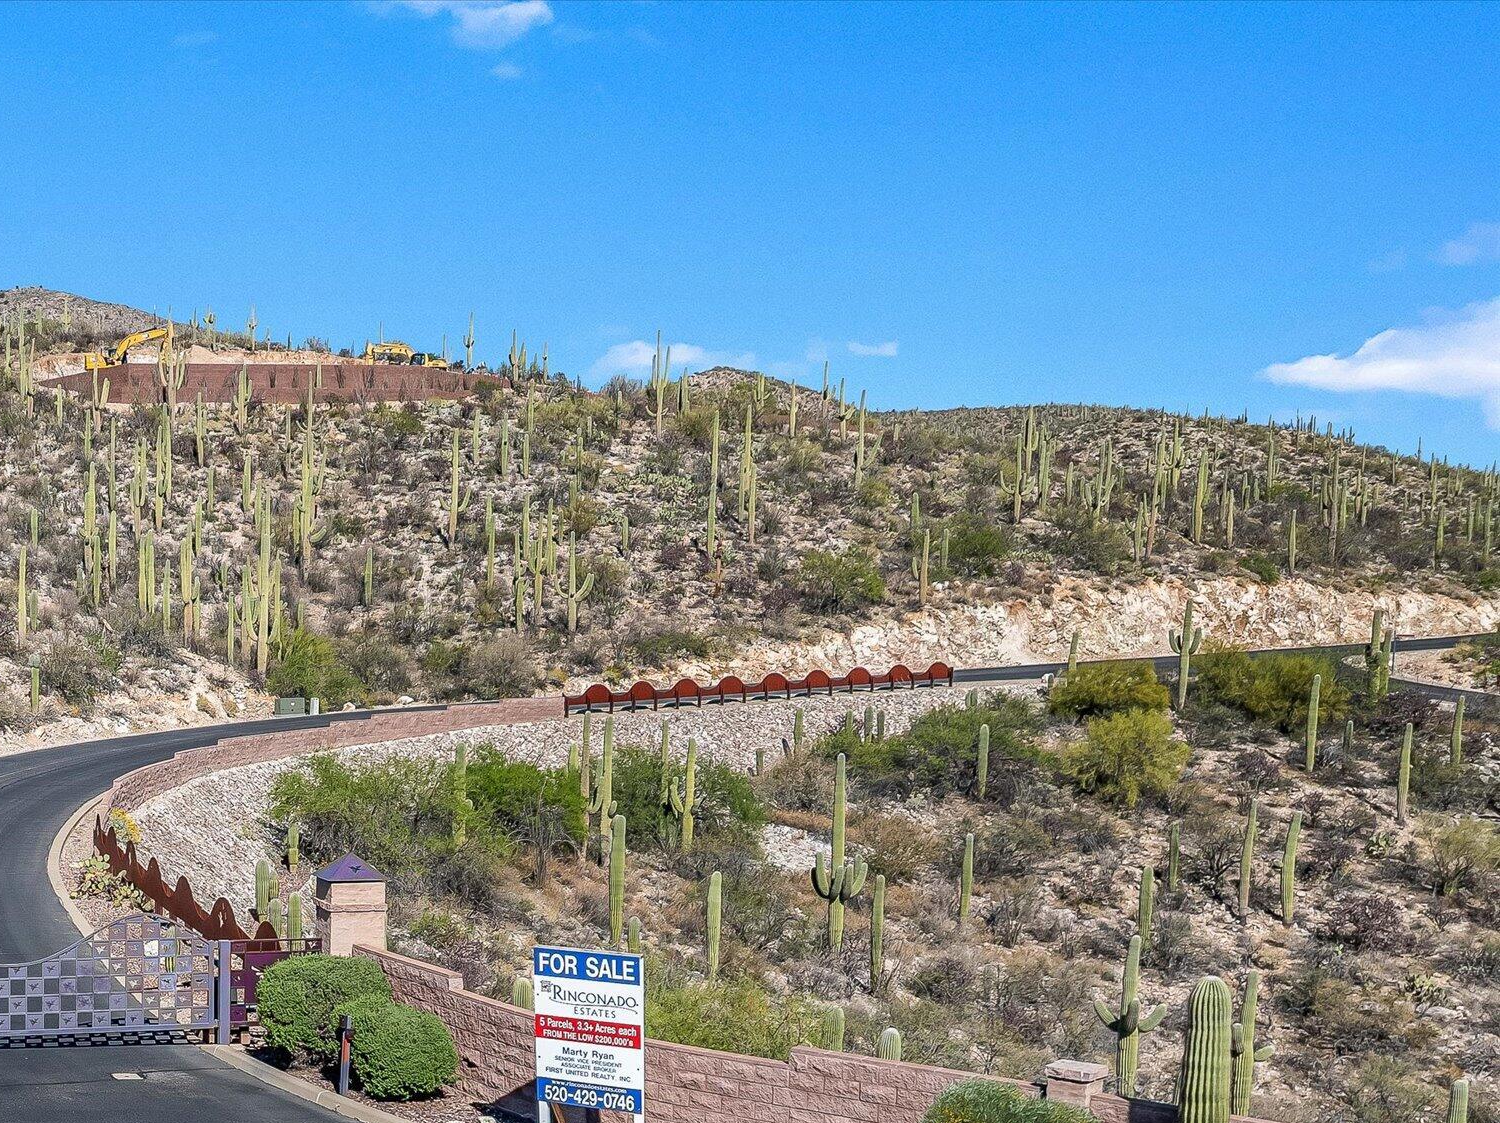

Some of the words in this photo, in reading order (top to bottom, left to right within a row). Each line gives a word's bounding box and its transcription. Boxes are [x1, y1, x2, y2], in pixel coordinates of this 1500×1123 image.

[538, 952, 577, 975] FOR
[586, 957, 635, 981] SALE
[552, 984, 637, 1008] RINCONADO
[573, 1006, 616, 1019] ESTATES
[539, 1017, 545, 1026] 5
[547, 1017, 575, 1031] Parcels,
[577, 1021, 594, 1032] 3.3+
[595, 1024, 617, 1035] Acres
[618, 1026, 637, 1037] each
[543, 1028, 563, 1038] FROM
[563, 1031, 577, 1040] THE
[578, 1033, 594, 1042] LOW
[562, 1046, 588, 1058] Marty
[592, 1049, 615, 1061] Ryan
[554, 1055, 575, 1063] SENIOR
[591, 1059, 622, 1069] PRESIDENT
[560, 1062, 591, 1071] ASSOCIATE
[593, 1066, 617, 1074] BROKER
[545, 1066, 563, 1075] FIRST
[565, 1069, 589, 1078] UNITED
[544, 1084, 635, 1112] 520-429-0746
